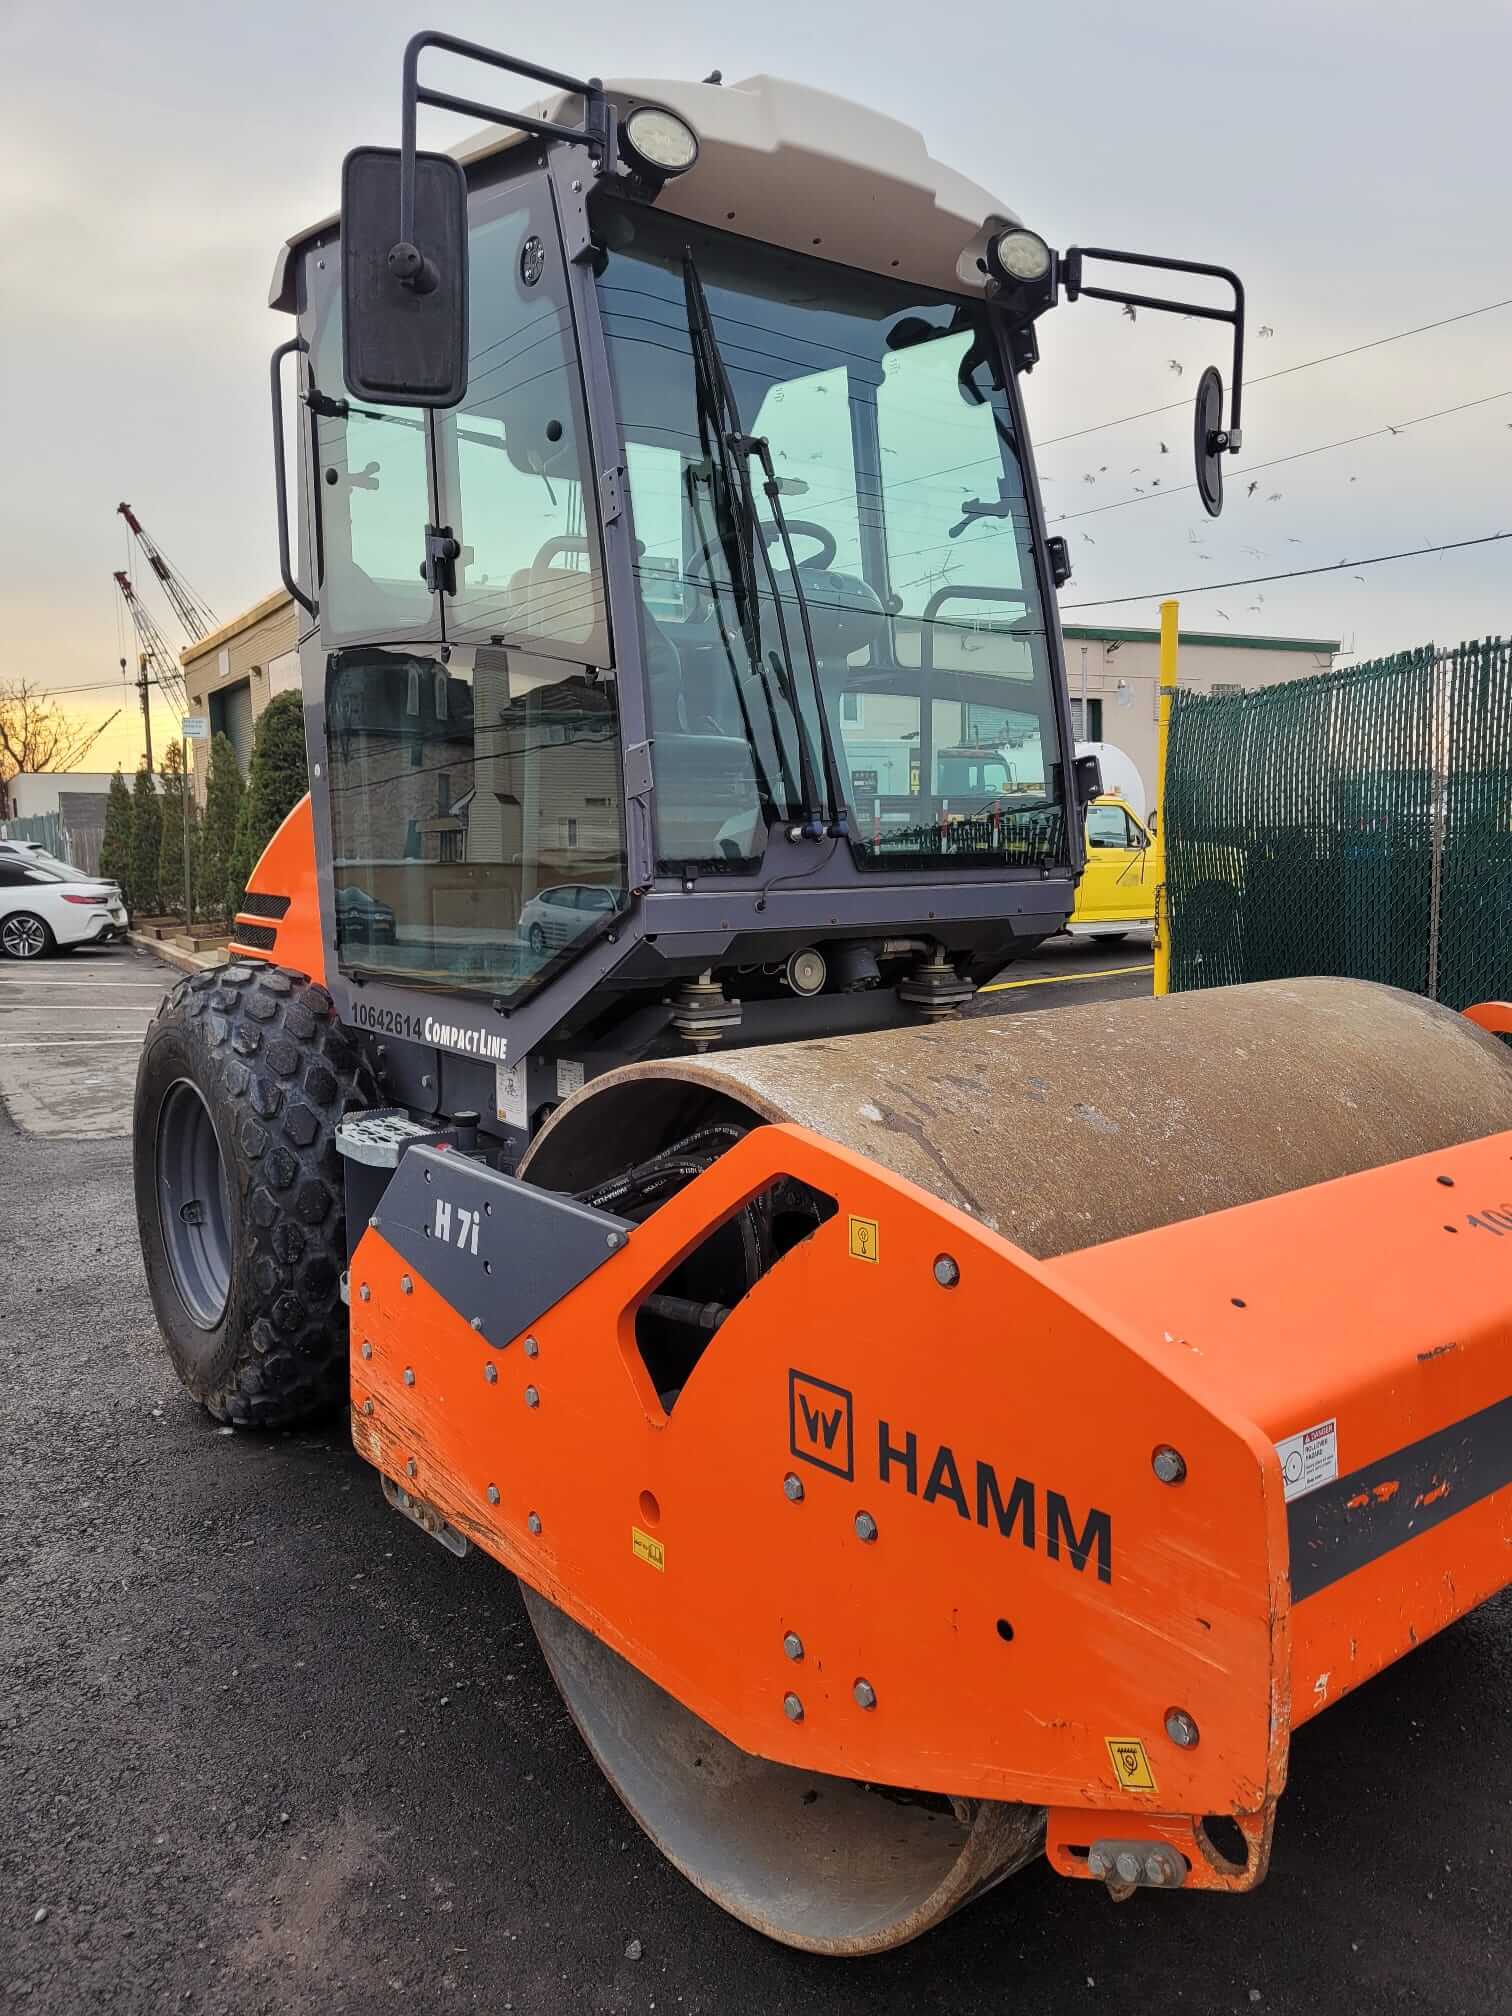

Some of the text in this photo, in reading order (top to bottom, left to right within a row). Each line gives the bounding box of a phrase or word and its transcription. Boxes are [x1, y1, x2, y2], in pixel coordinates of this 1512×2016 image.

[351, 1002, 422, 1040] 10642614
[435, 1199, 480, 1256] H 7i
[878, 1420, 1111, 1585] HAMM
